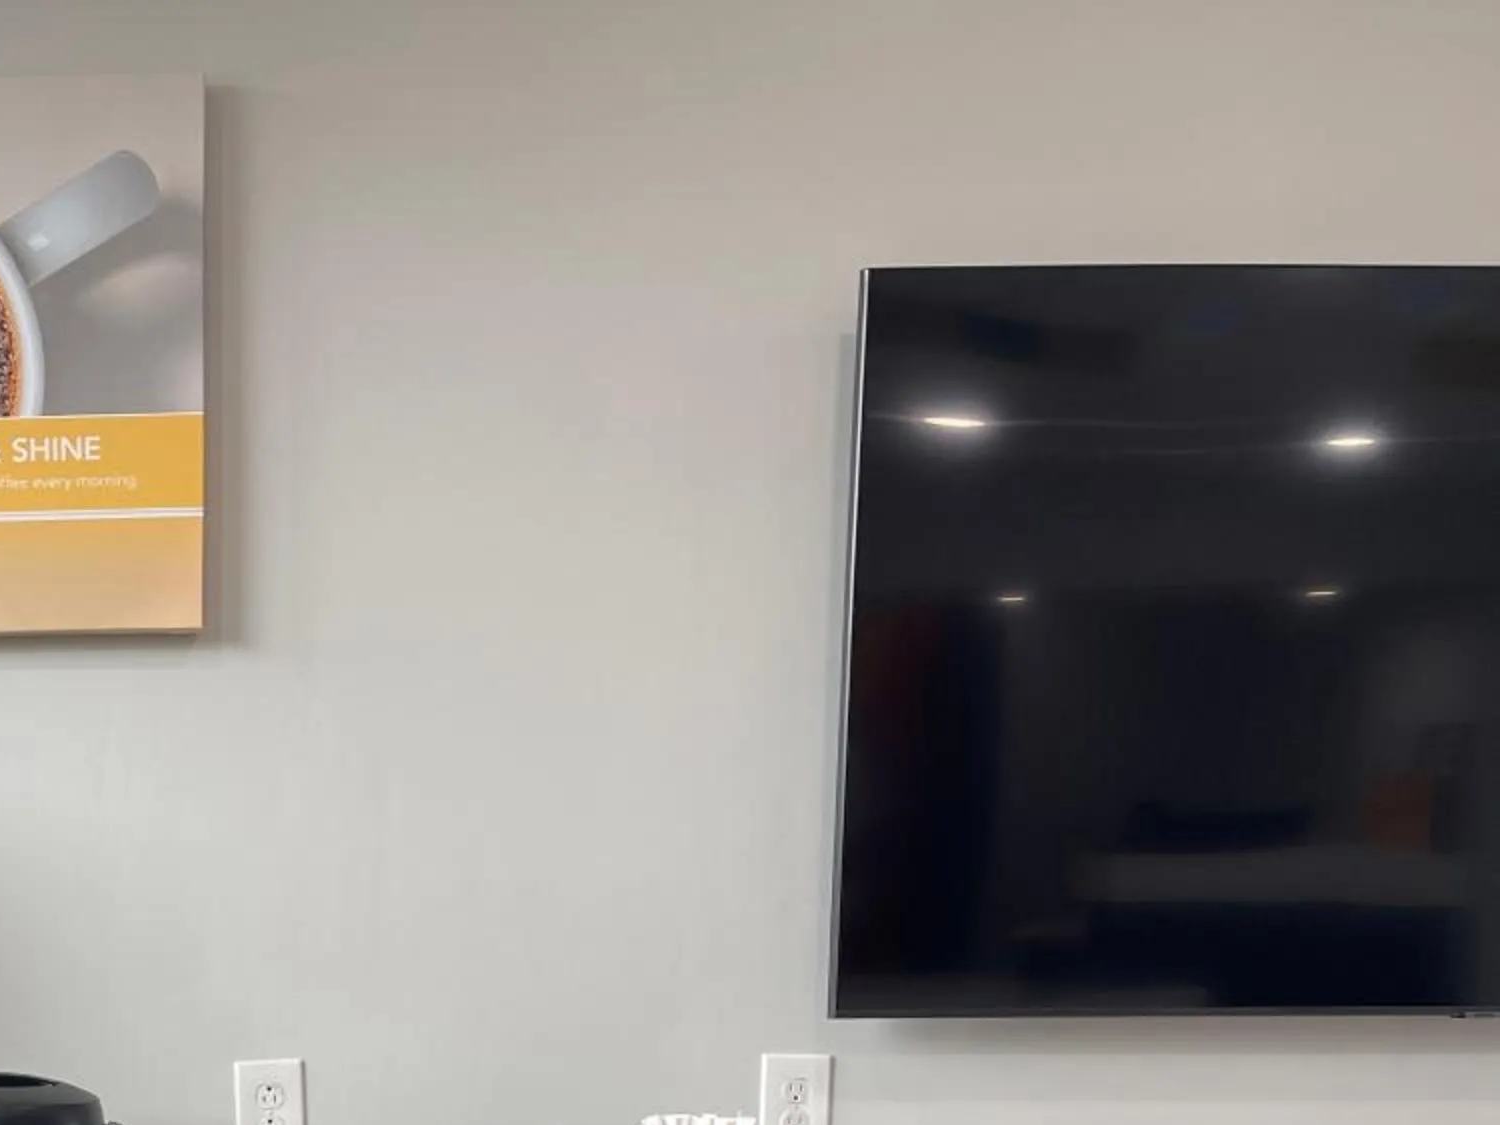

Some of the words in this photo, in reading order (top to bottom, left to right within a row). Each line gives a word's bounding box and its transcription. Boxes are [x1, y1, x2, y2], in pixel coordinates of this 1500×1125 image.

[11, 435, 101, 463] SHINE
[32, 476, 71, 491] every
[75, 474, 137, 490] morning
